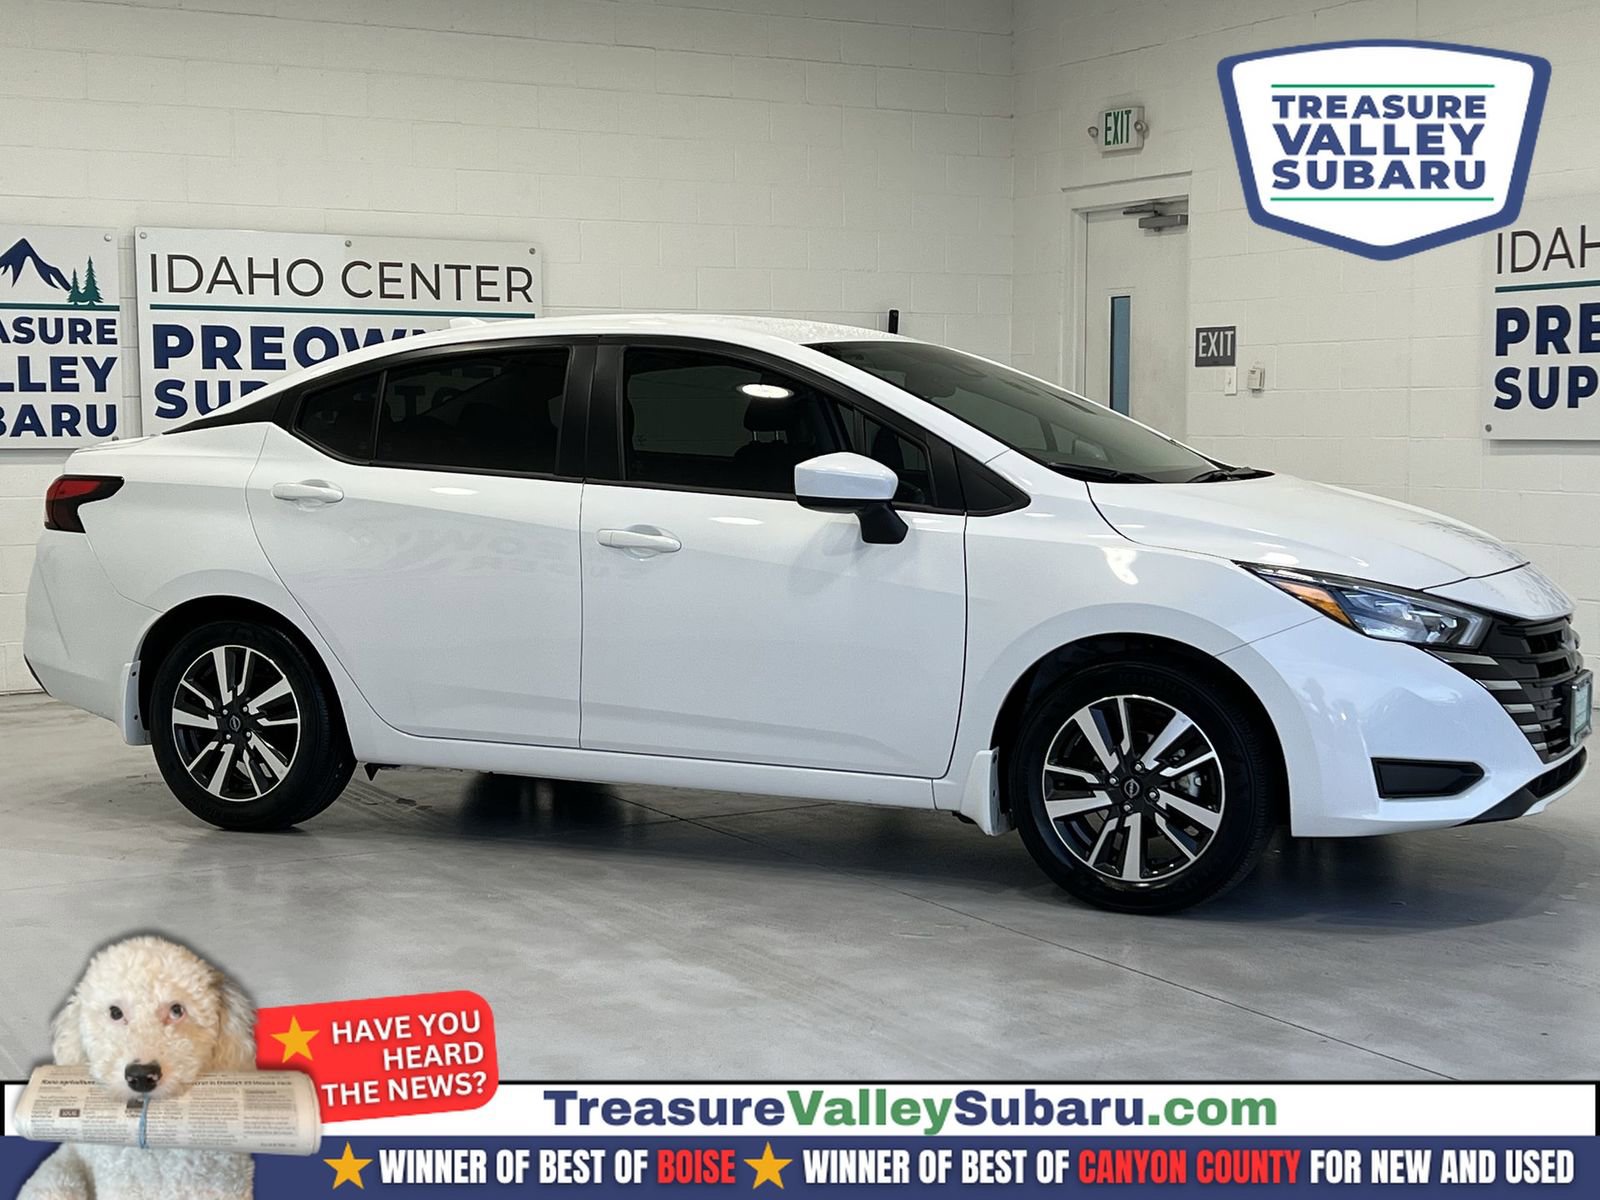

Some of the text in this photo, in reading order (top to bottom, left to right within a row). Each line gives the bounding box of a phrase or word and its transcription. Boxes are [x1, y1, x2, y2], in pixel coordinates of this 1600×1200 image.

[1104, 109, 1132, 146] EXIT
[150, 253, 534, 303] IDAHO CENTER
[1199, 330, 1234, 357] EXIT
[0, 355, 118, 393] LEY
[1494, 366, 1599, 410] SUP
[0, 404, 117, 437] ARU
